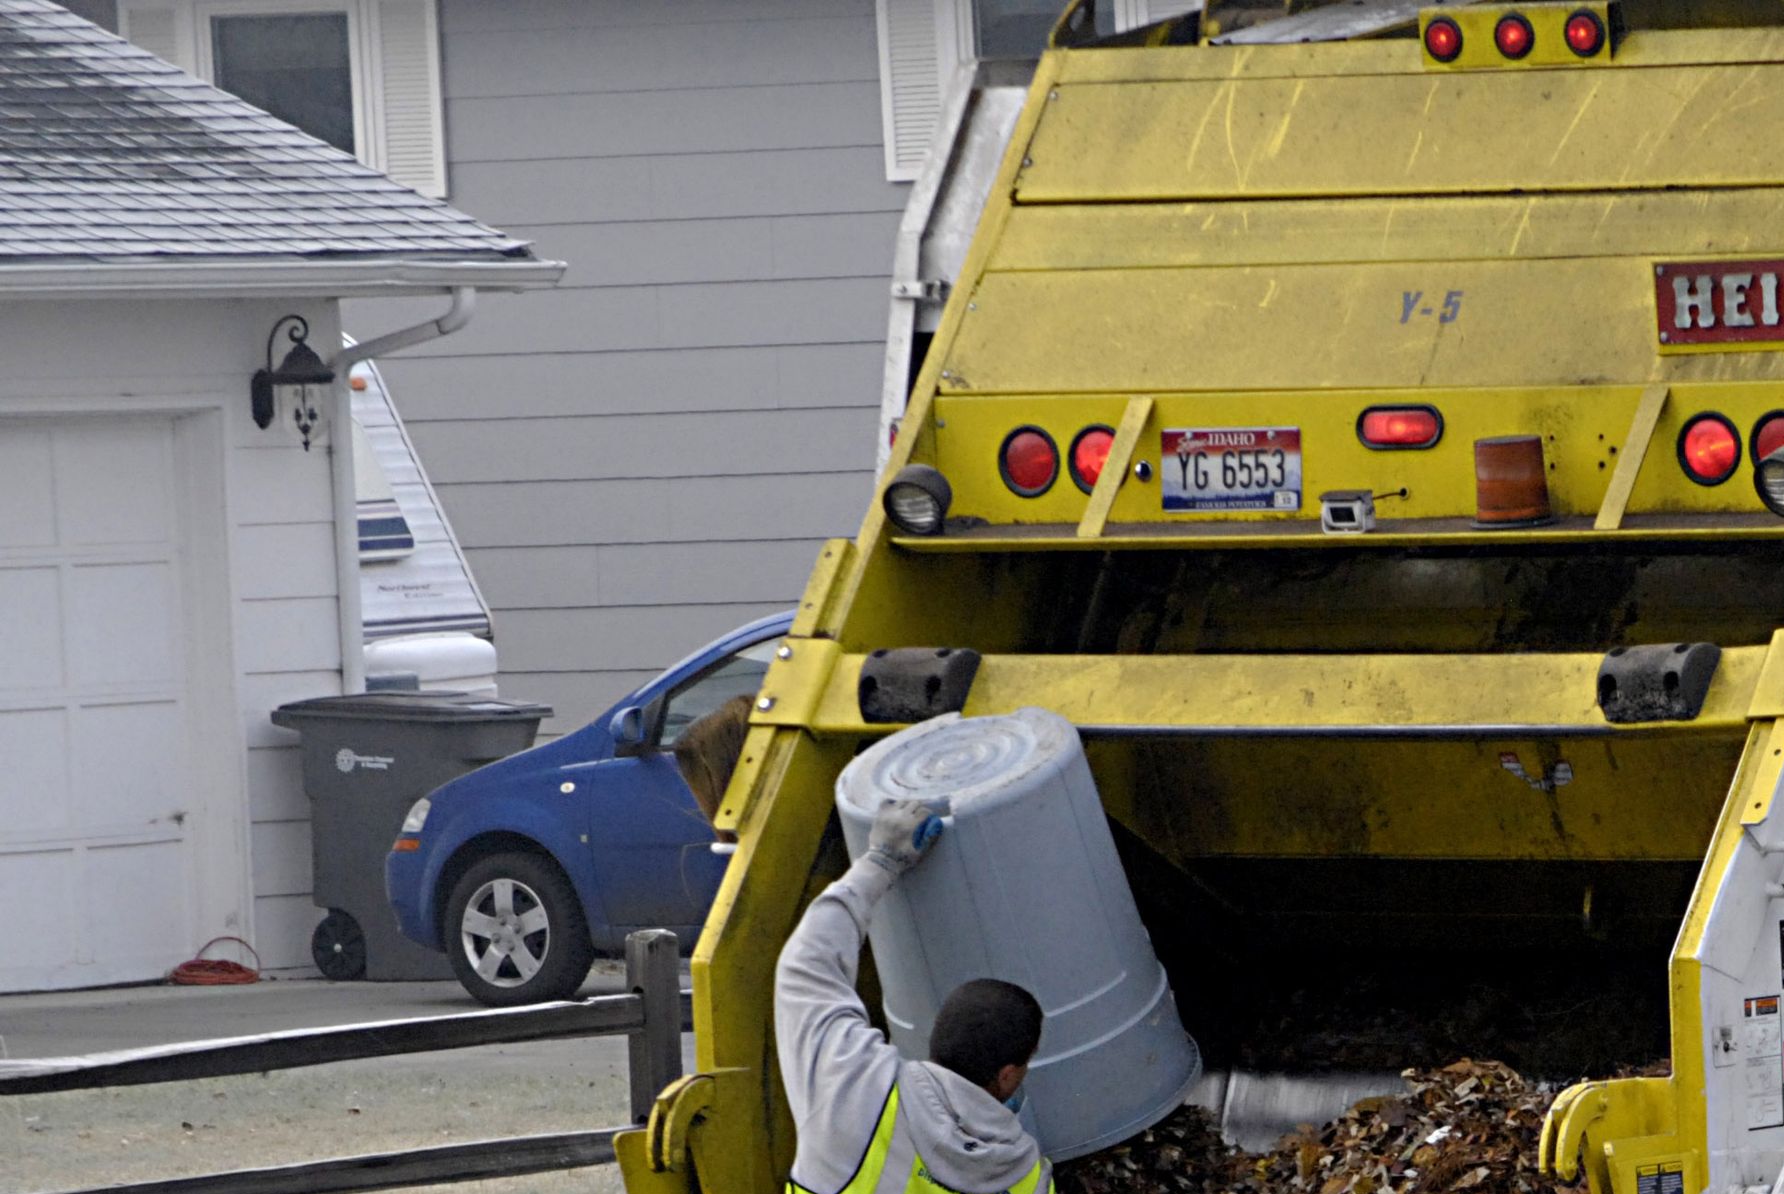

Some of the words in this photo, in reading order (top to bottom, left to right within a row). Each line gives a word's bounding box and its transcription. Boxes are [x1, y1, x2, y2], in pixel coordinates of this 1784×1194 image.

[1399, 290, 1464, 324] Y-5
[1208, 432, 1256, 446] IDAHO
[1178, 450, 1209, 491] YG
[1222, 448, 1286, 489] 6553
